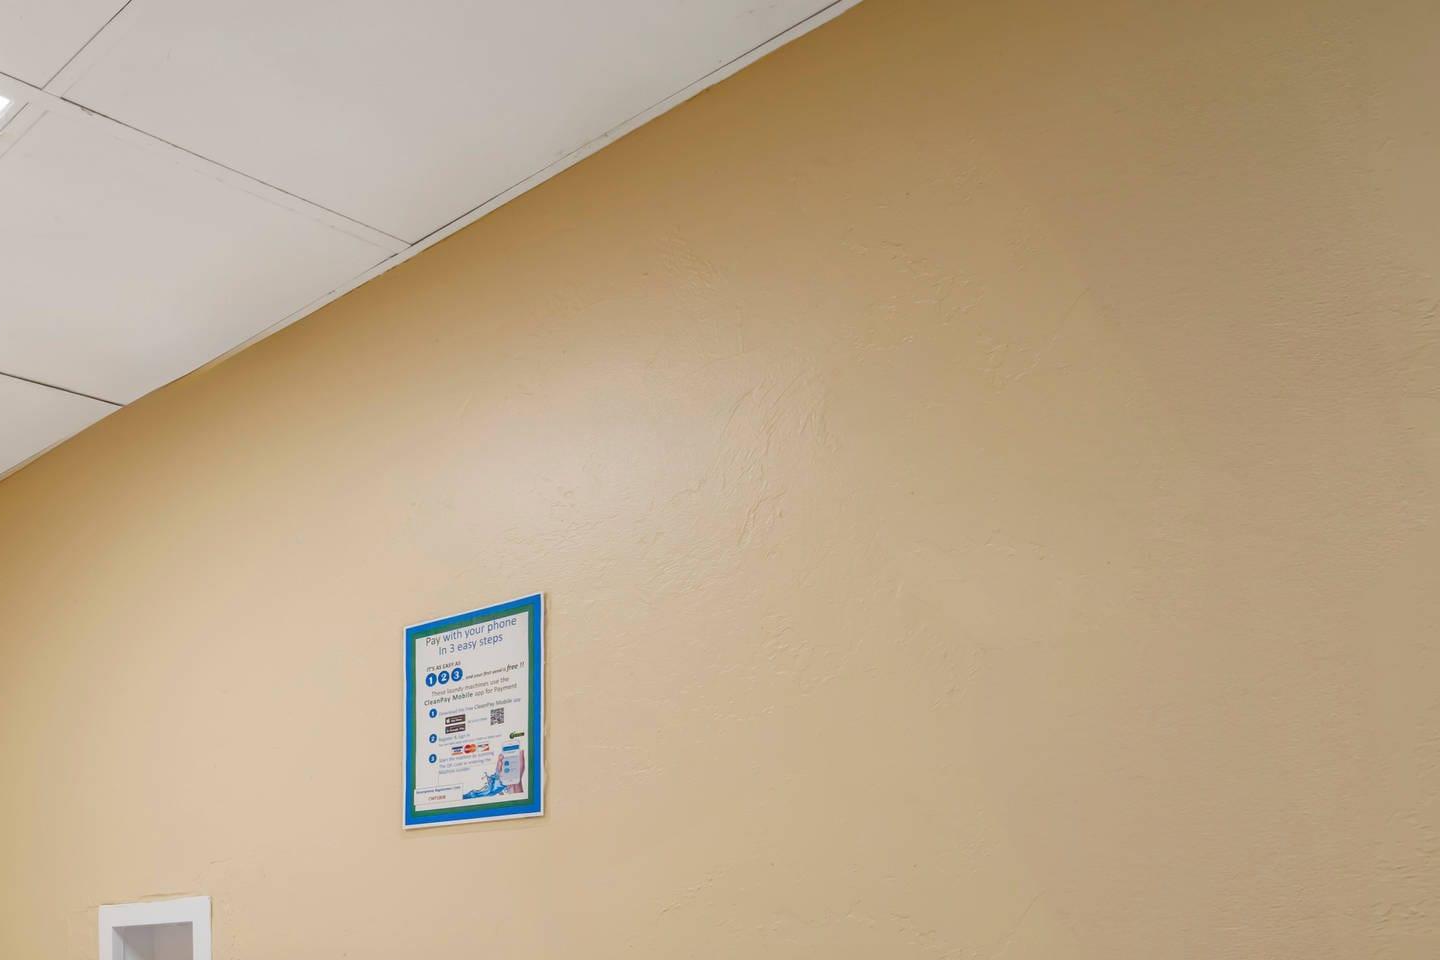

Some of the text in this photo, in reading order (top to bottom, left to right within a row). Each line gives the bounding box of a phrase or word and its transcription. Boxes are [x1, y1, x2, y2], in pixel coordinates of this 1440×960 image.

[425, 617, 517, 647] Pay with your phone
[449, 643, 455, 653] 3
[457, 640, 477, 650] easy
[479, 634, 503, 647] steps
[505, 663, 519, 672] free
[424, 695, 450, 706] CleanPay
[452, 691, 473, 700] Mobile
